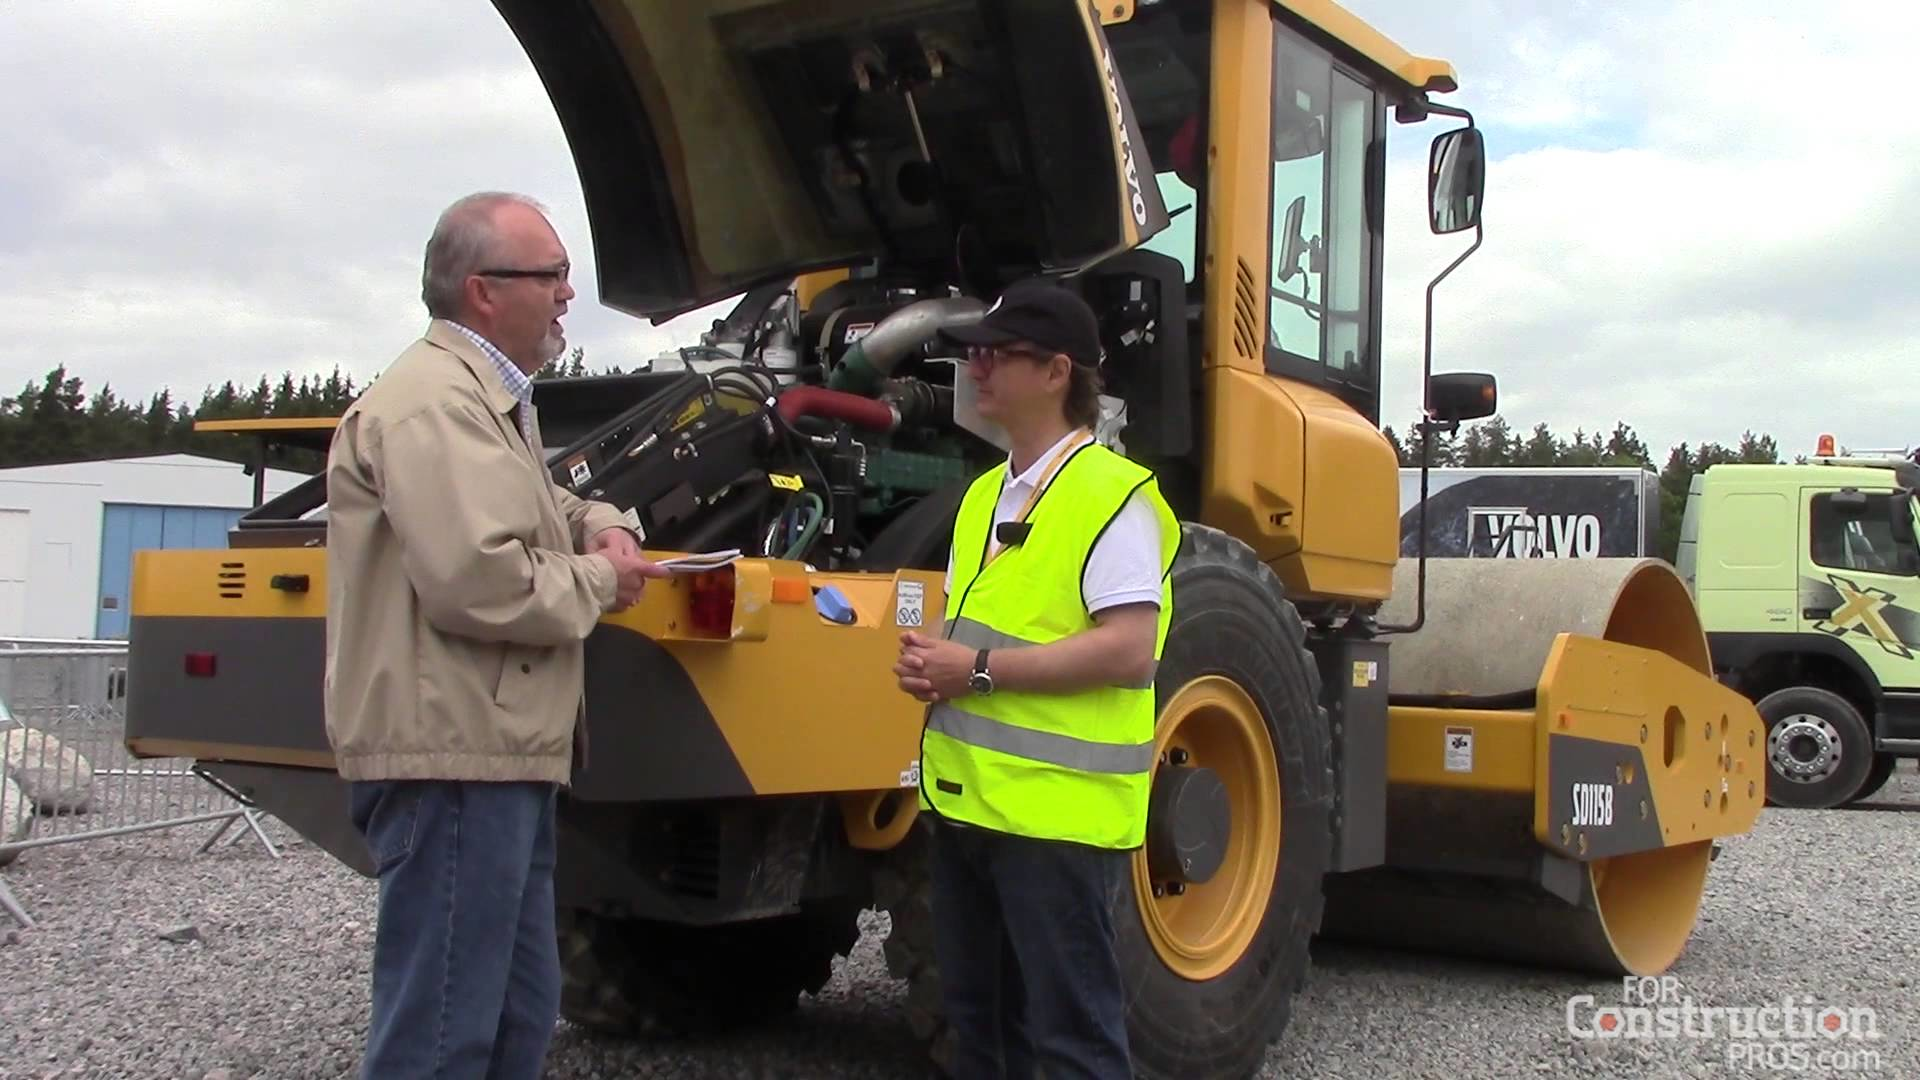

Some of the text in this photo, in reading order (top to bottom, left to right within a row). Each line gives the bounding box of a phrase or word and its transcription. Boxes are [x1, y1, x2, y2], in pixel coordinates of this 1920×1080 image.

[1102, 49, 1146, 225] VOLVO
[1488, 514, 1601, 558] VOLVO
[1572, 783, 1614, 825] SD115B
